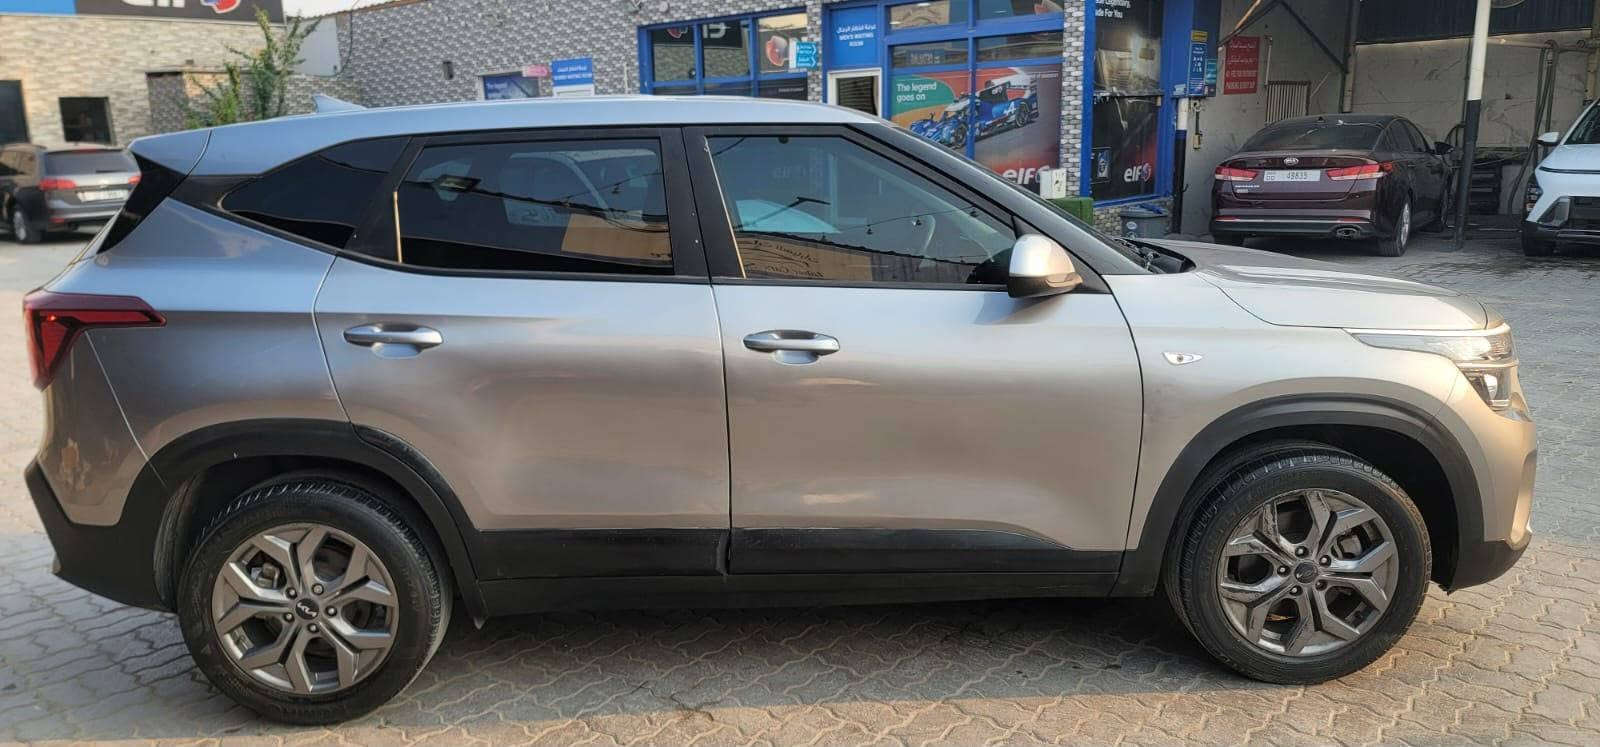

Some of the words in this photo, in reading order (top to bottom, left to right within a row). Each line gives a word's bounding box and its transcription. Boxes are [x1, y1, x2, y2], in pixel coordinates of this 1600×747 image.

[1105, 8, 1114, 18] For
[1114, 10, 1123, 19] You
[896, 83, 911, 92] The
[911, 81, 937, 94] legend
[896, 94, 914, 103] goes
[915, 93, 926, 101] on
[1002, 167, 1036, 185] elf
[1123, 164, 1142, 183] elf
